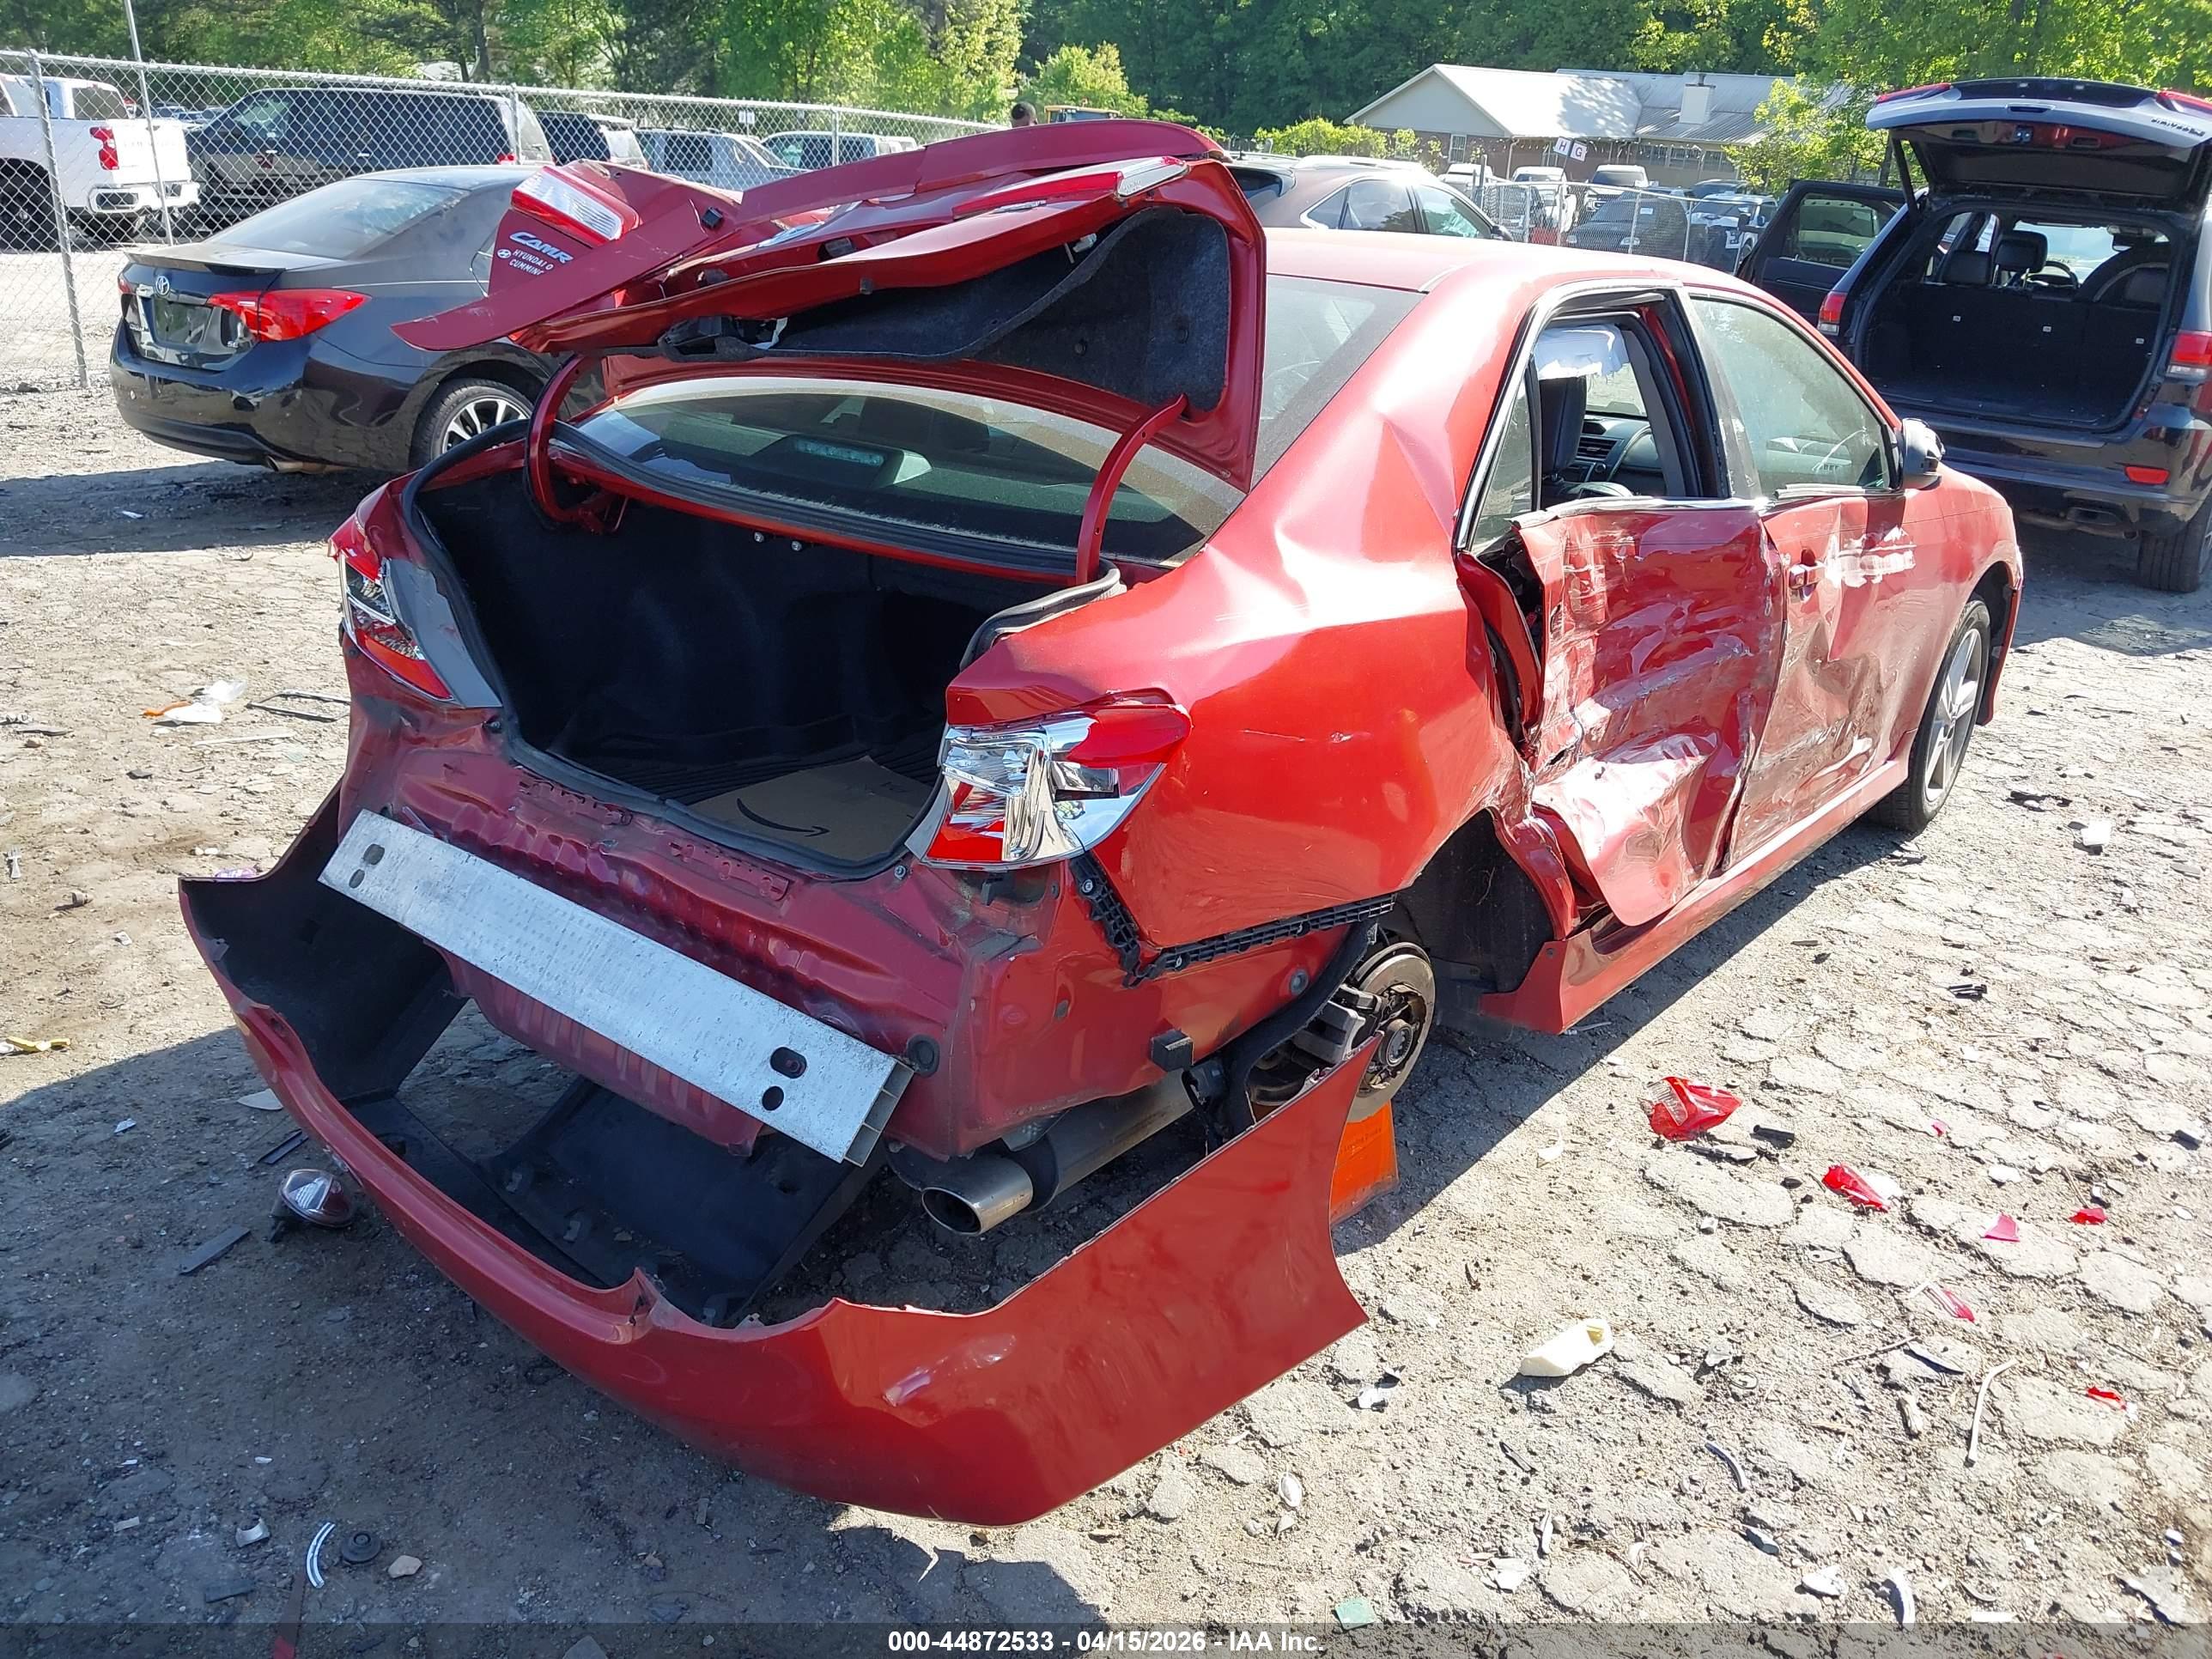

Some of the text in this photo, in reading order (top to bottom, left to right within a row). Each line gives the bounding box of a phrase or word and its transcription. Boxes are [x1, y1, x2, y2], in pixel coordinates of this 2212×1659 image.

[1559, 140, 1583, 156] H G
[513, 249, 548, 268] HYUNDAI
